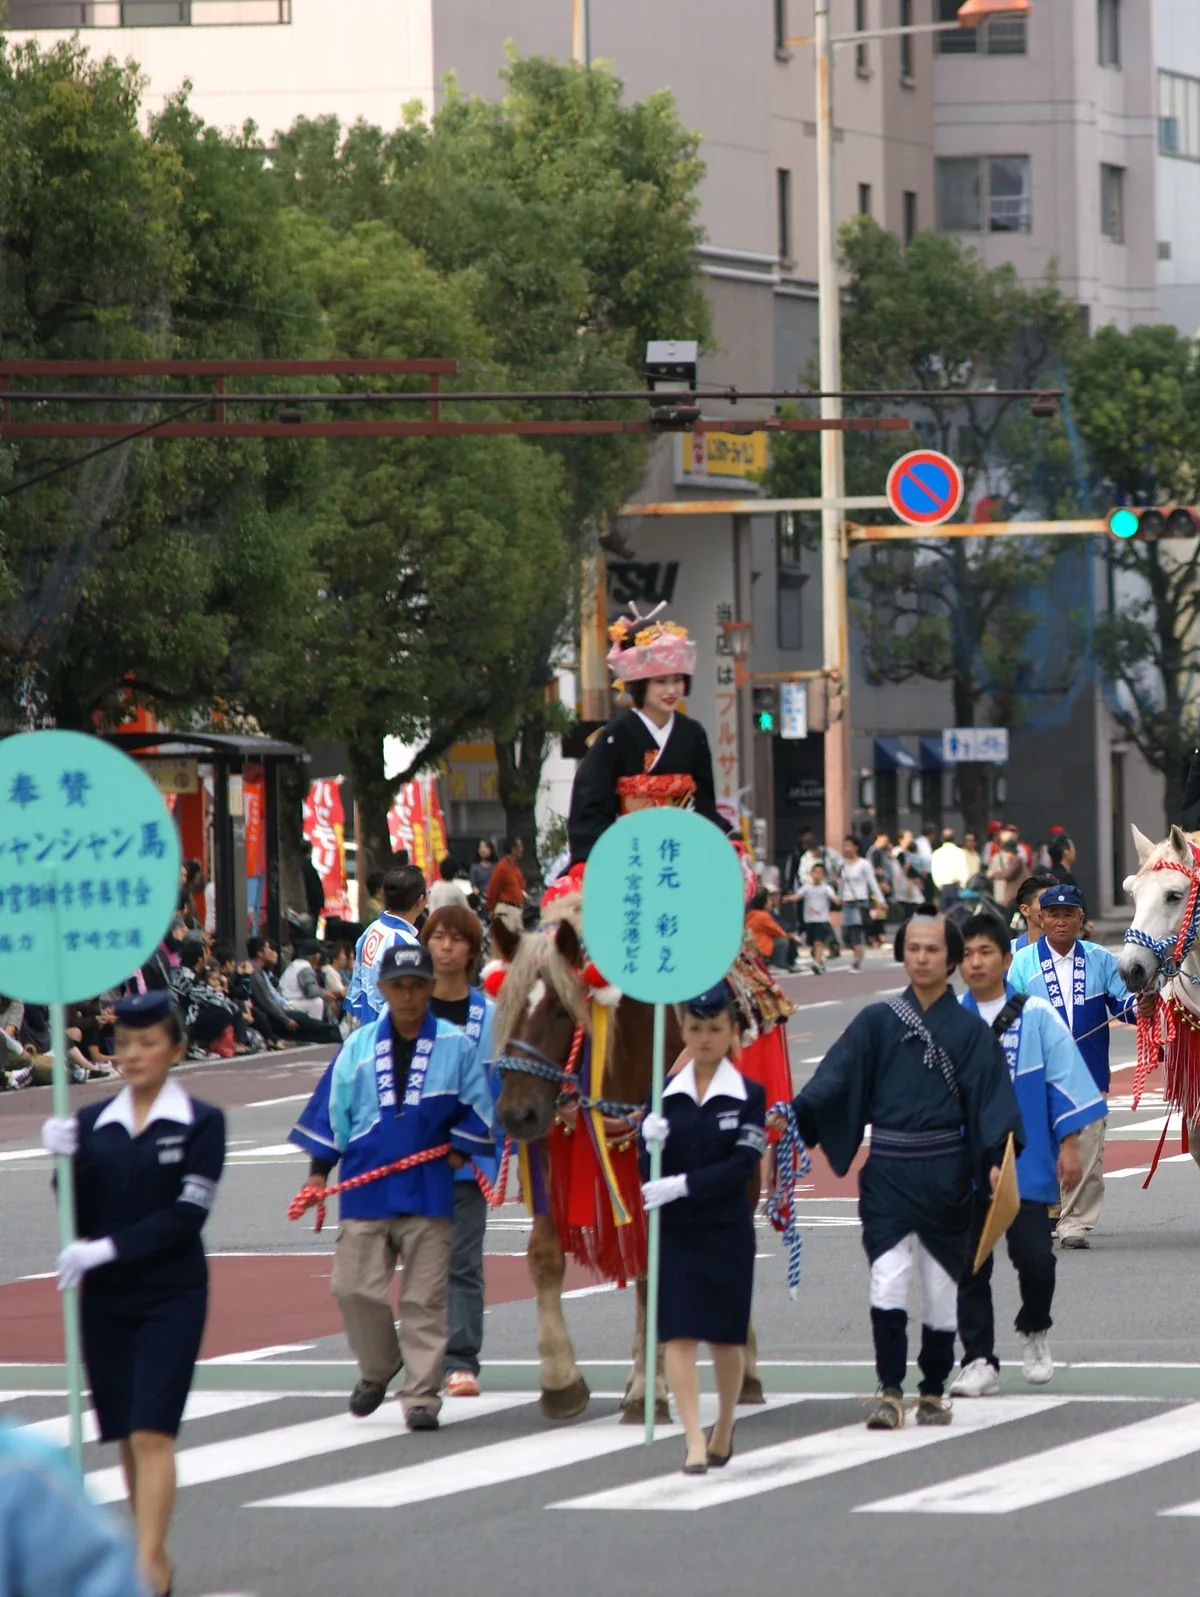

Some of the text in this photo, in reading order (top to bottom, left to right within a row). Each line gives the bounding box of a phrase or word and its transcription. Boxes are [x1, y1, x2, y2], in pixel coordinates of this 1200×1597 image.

[0, 821, 167, 861] ャンシャン馬
[656, 838, 680, 889] 作元
[1041, 959, 1064, 1008] 宮崎交通
[1074, 956, 1085, 1006] 宮崎交通
[375, 1037, 397, 1108] 宮崎交通
[403, 1037, 434, 1107] 宮崎交通
